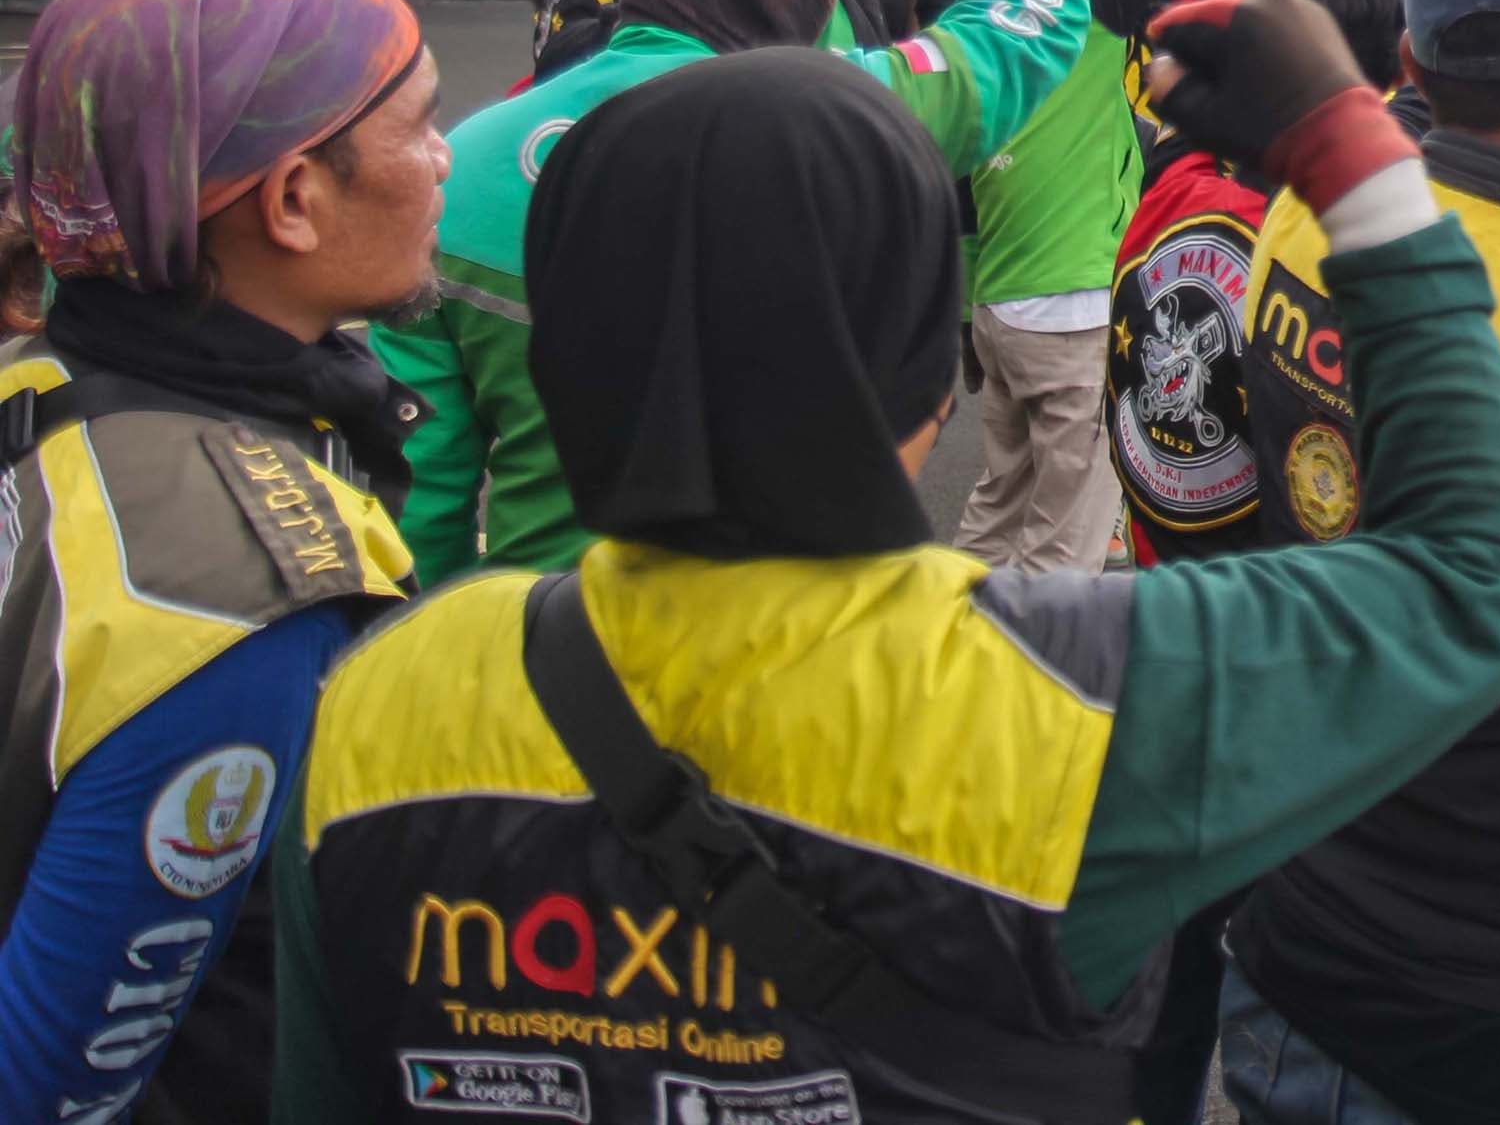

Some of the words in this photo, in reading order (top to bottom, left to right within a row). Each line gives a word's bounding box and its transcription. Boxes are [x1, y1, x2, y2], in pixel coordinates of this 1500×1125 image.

[1178, 249, 1248, 305] MAXIM
[1271, 350, 1357, 419] TRANSPORTA
[442, 999, 670, 1051] Transportasi
[679, 1021, 785, 1066] Online
[453, 1063, 495, 1079] GET
[498, 1064, 518, 1080] IT
[526, 1065, 561, 1083] ON
[456, 1080, 534, 1108] Google
